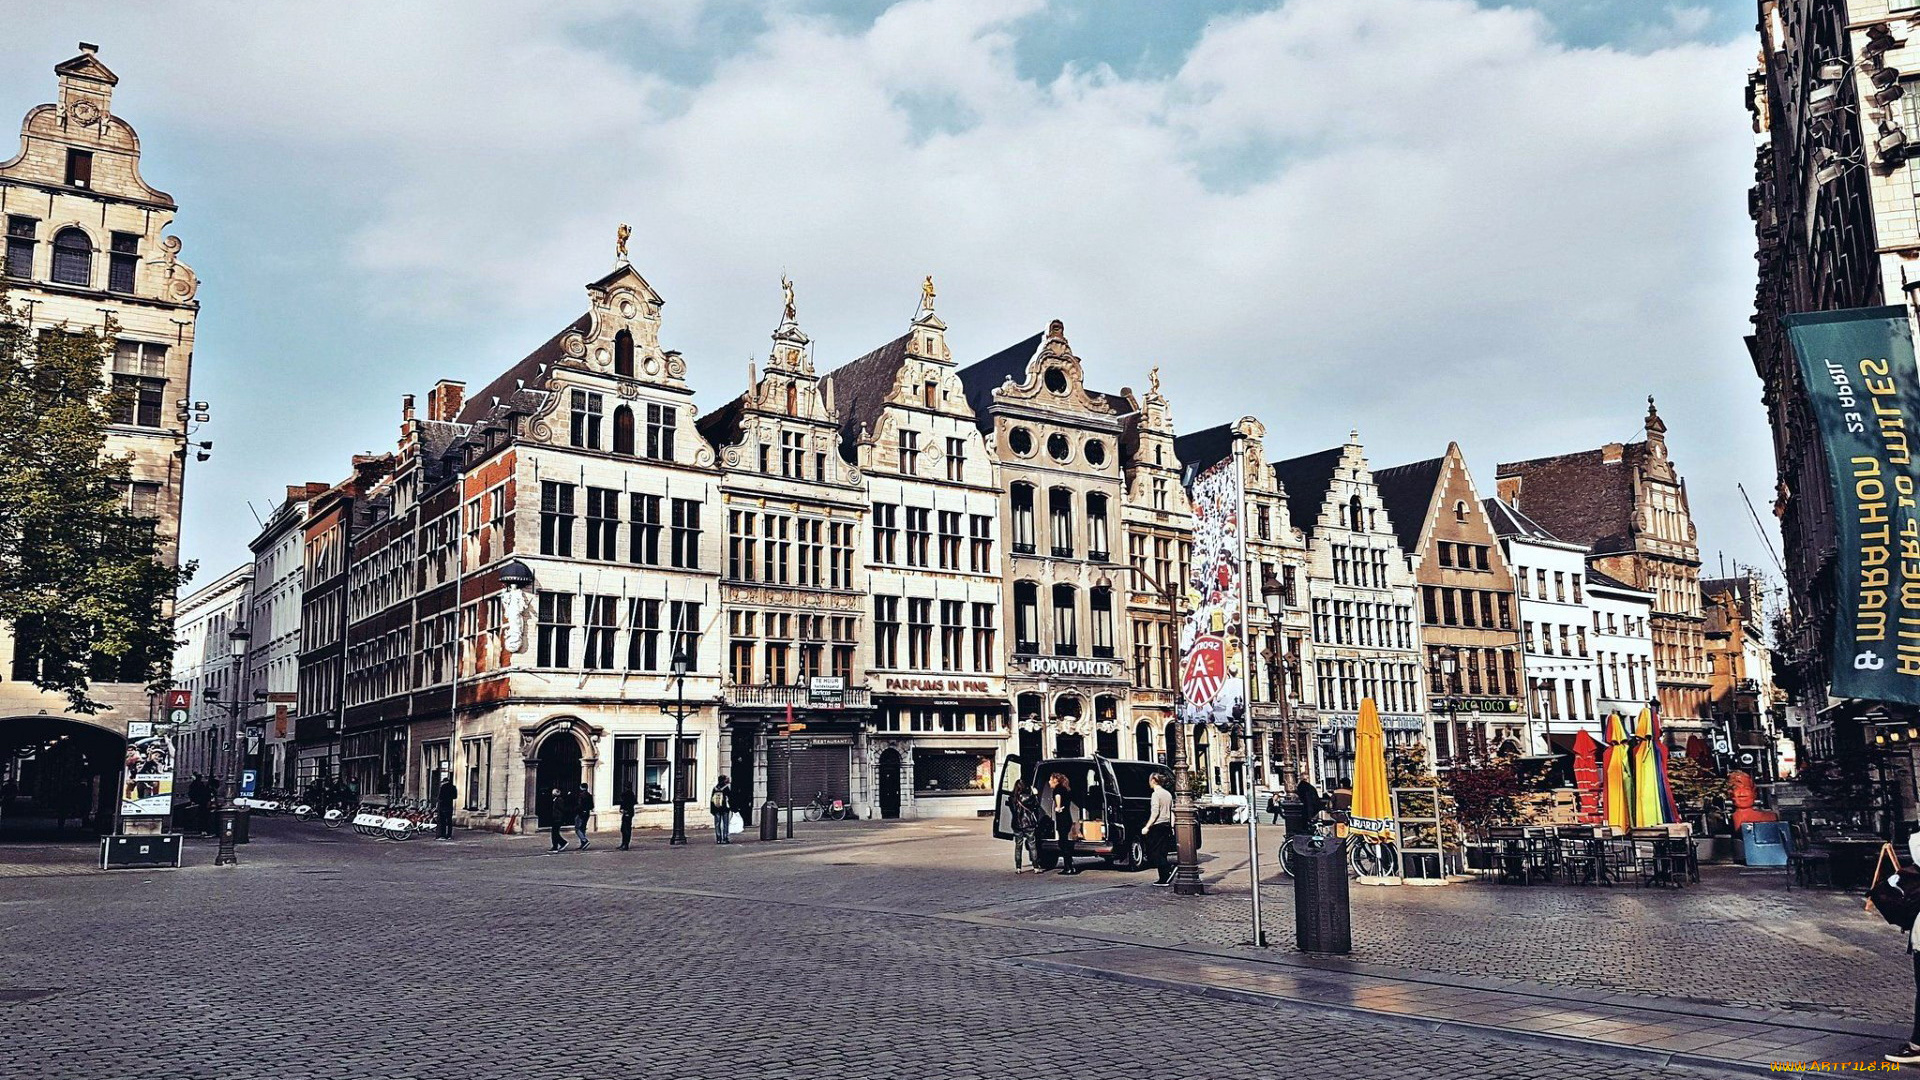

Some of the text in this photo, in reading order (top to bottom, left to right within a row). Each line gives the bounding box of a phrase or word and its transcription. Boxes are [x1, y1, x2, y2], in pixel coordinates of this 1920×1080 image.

[1030, 658, 1112, 676] BONAPARTE
[886, 678, 989, 692] PARFUMS IN FINE
[175, 695, 185, 705] A
[1455, 700, 1504, 711] OCO LOCO
[242, 773, 255, 788] P
